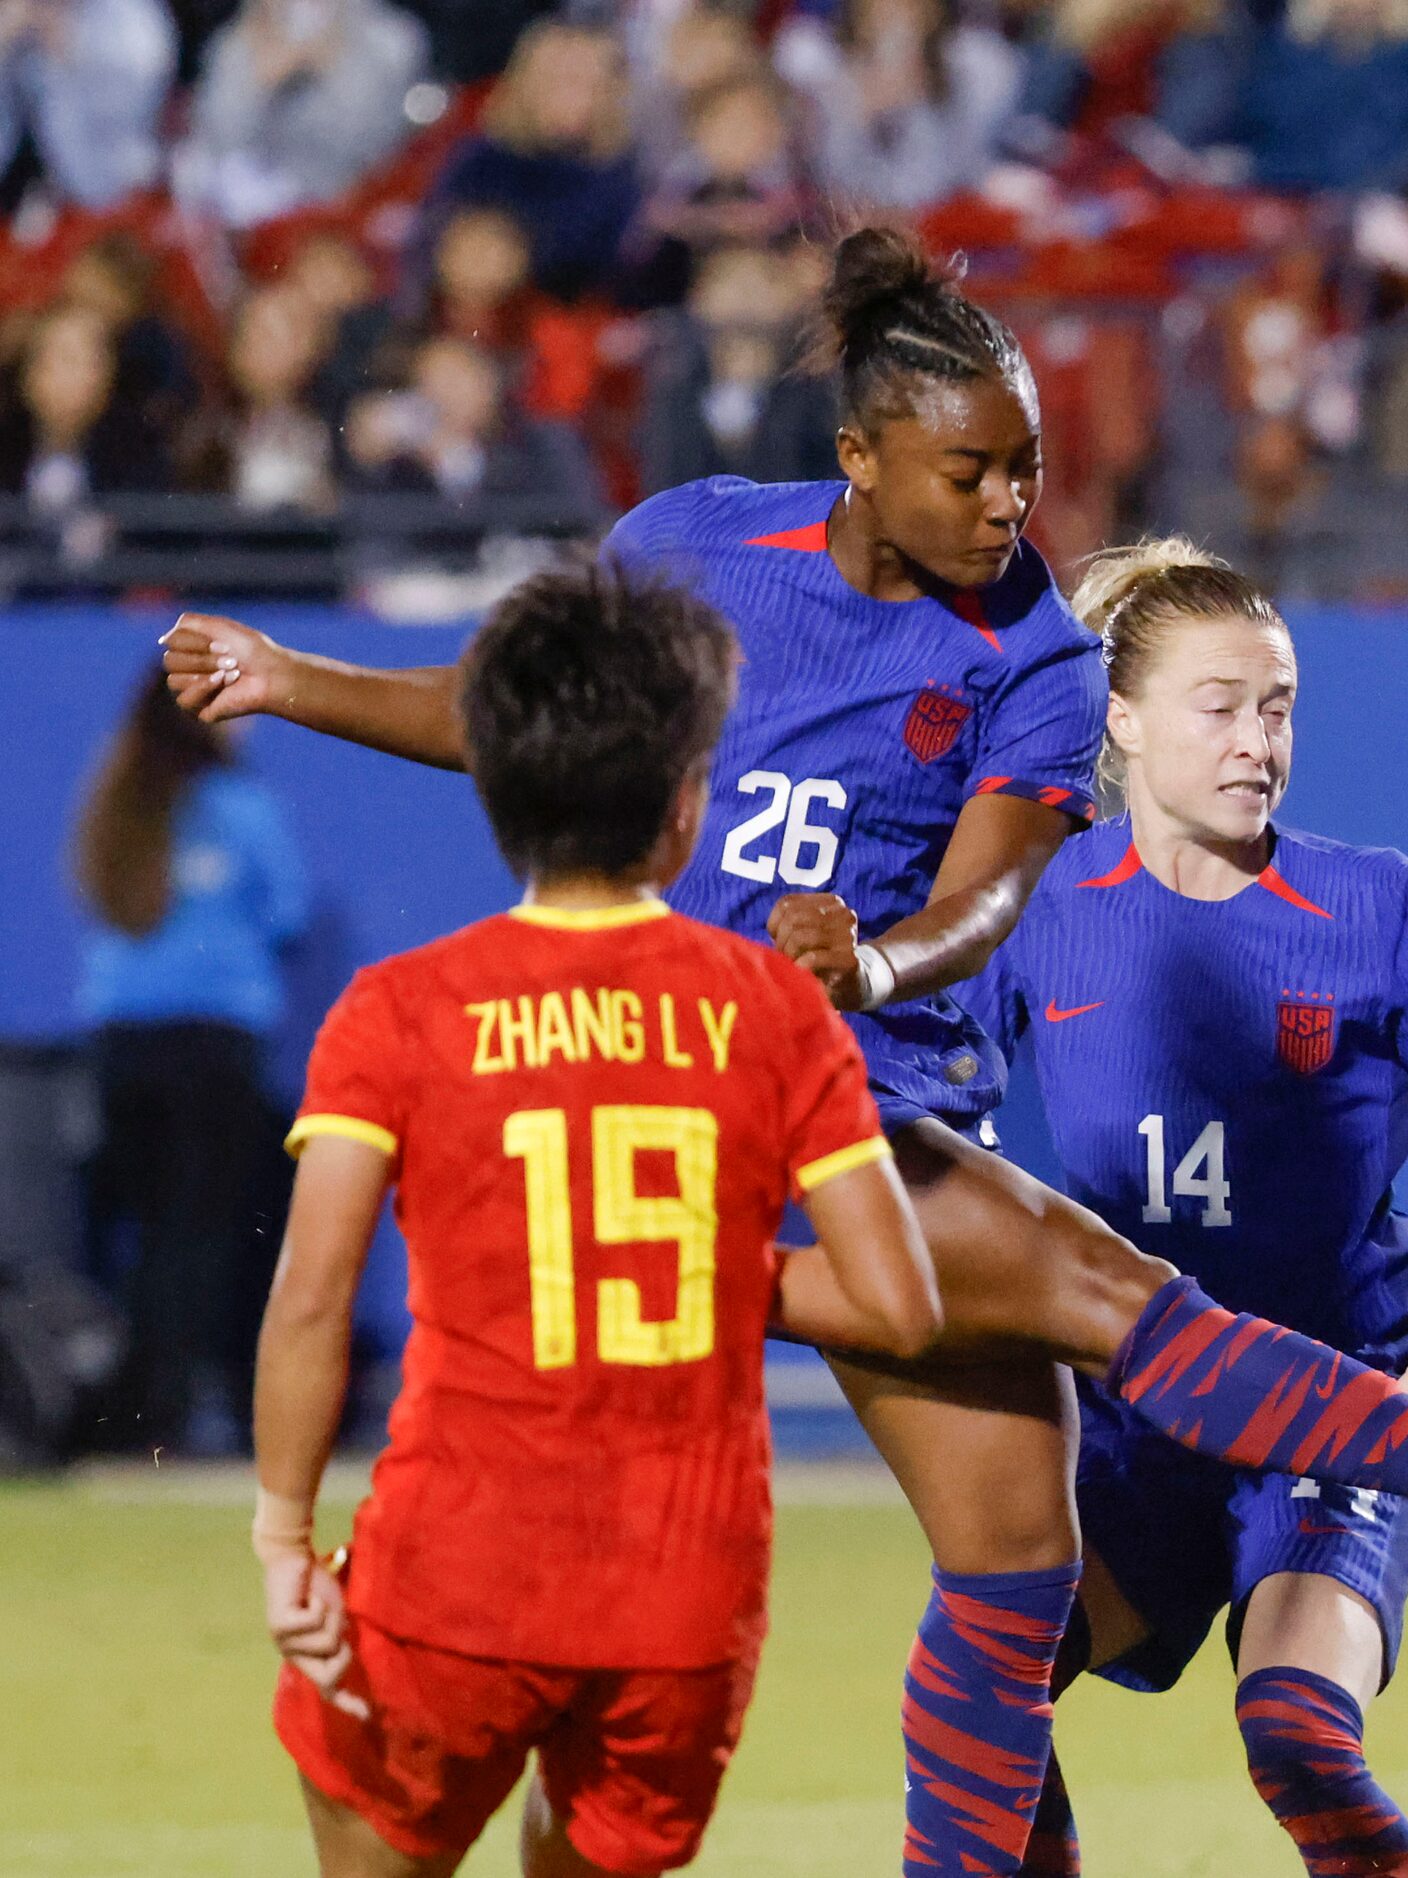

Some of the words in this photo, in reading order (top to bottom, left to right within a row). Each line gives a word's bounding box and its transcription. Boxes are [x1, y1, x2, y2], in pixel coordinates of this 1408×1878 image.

[917, 694, 969, 723] USA
[720, 769, 848, 888] 26
[464, 986, 645, 1076] ZHANG
[1281, 1006, 1331, 1036] USA
[1137, 1113, 1232, 1227] 14
[503, 1104, 718, 1371] 19
